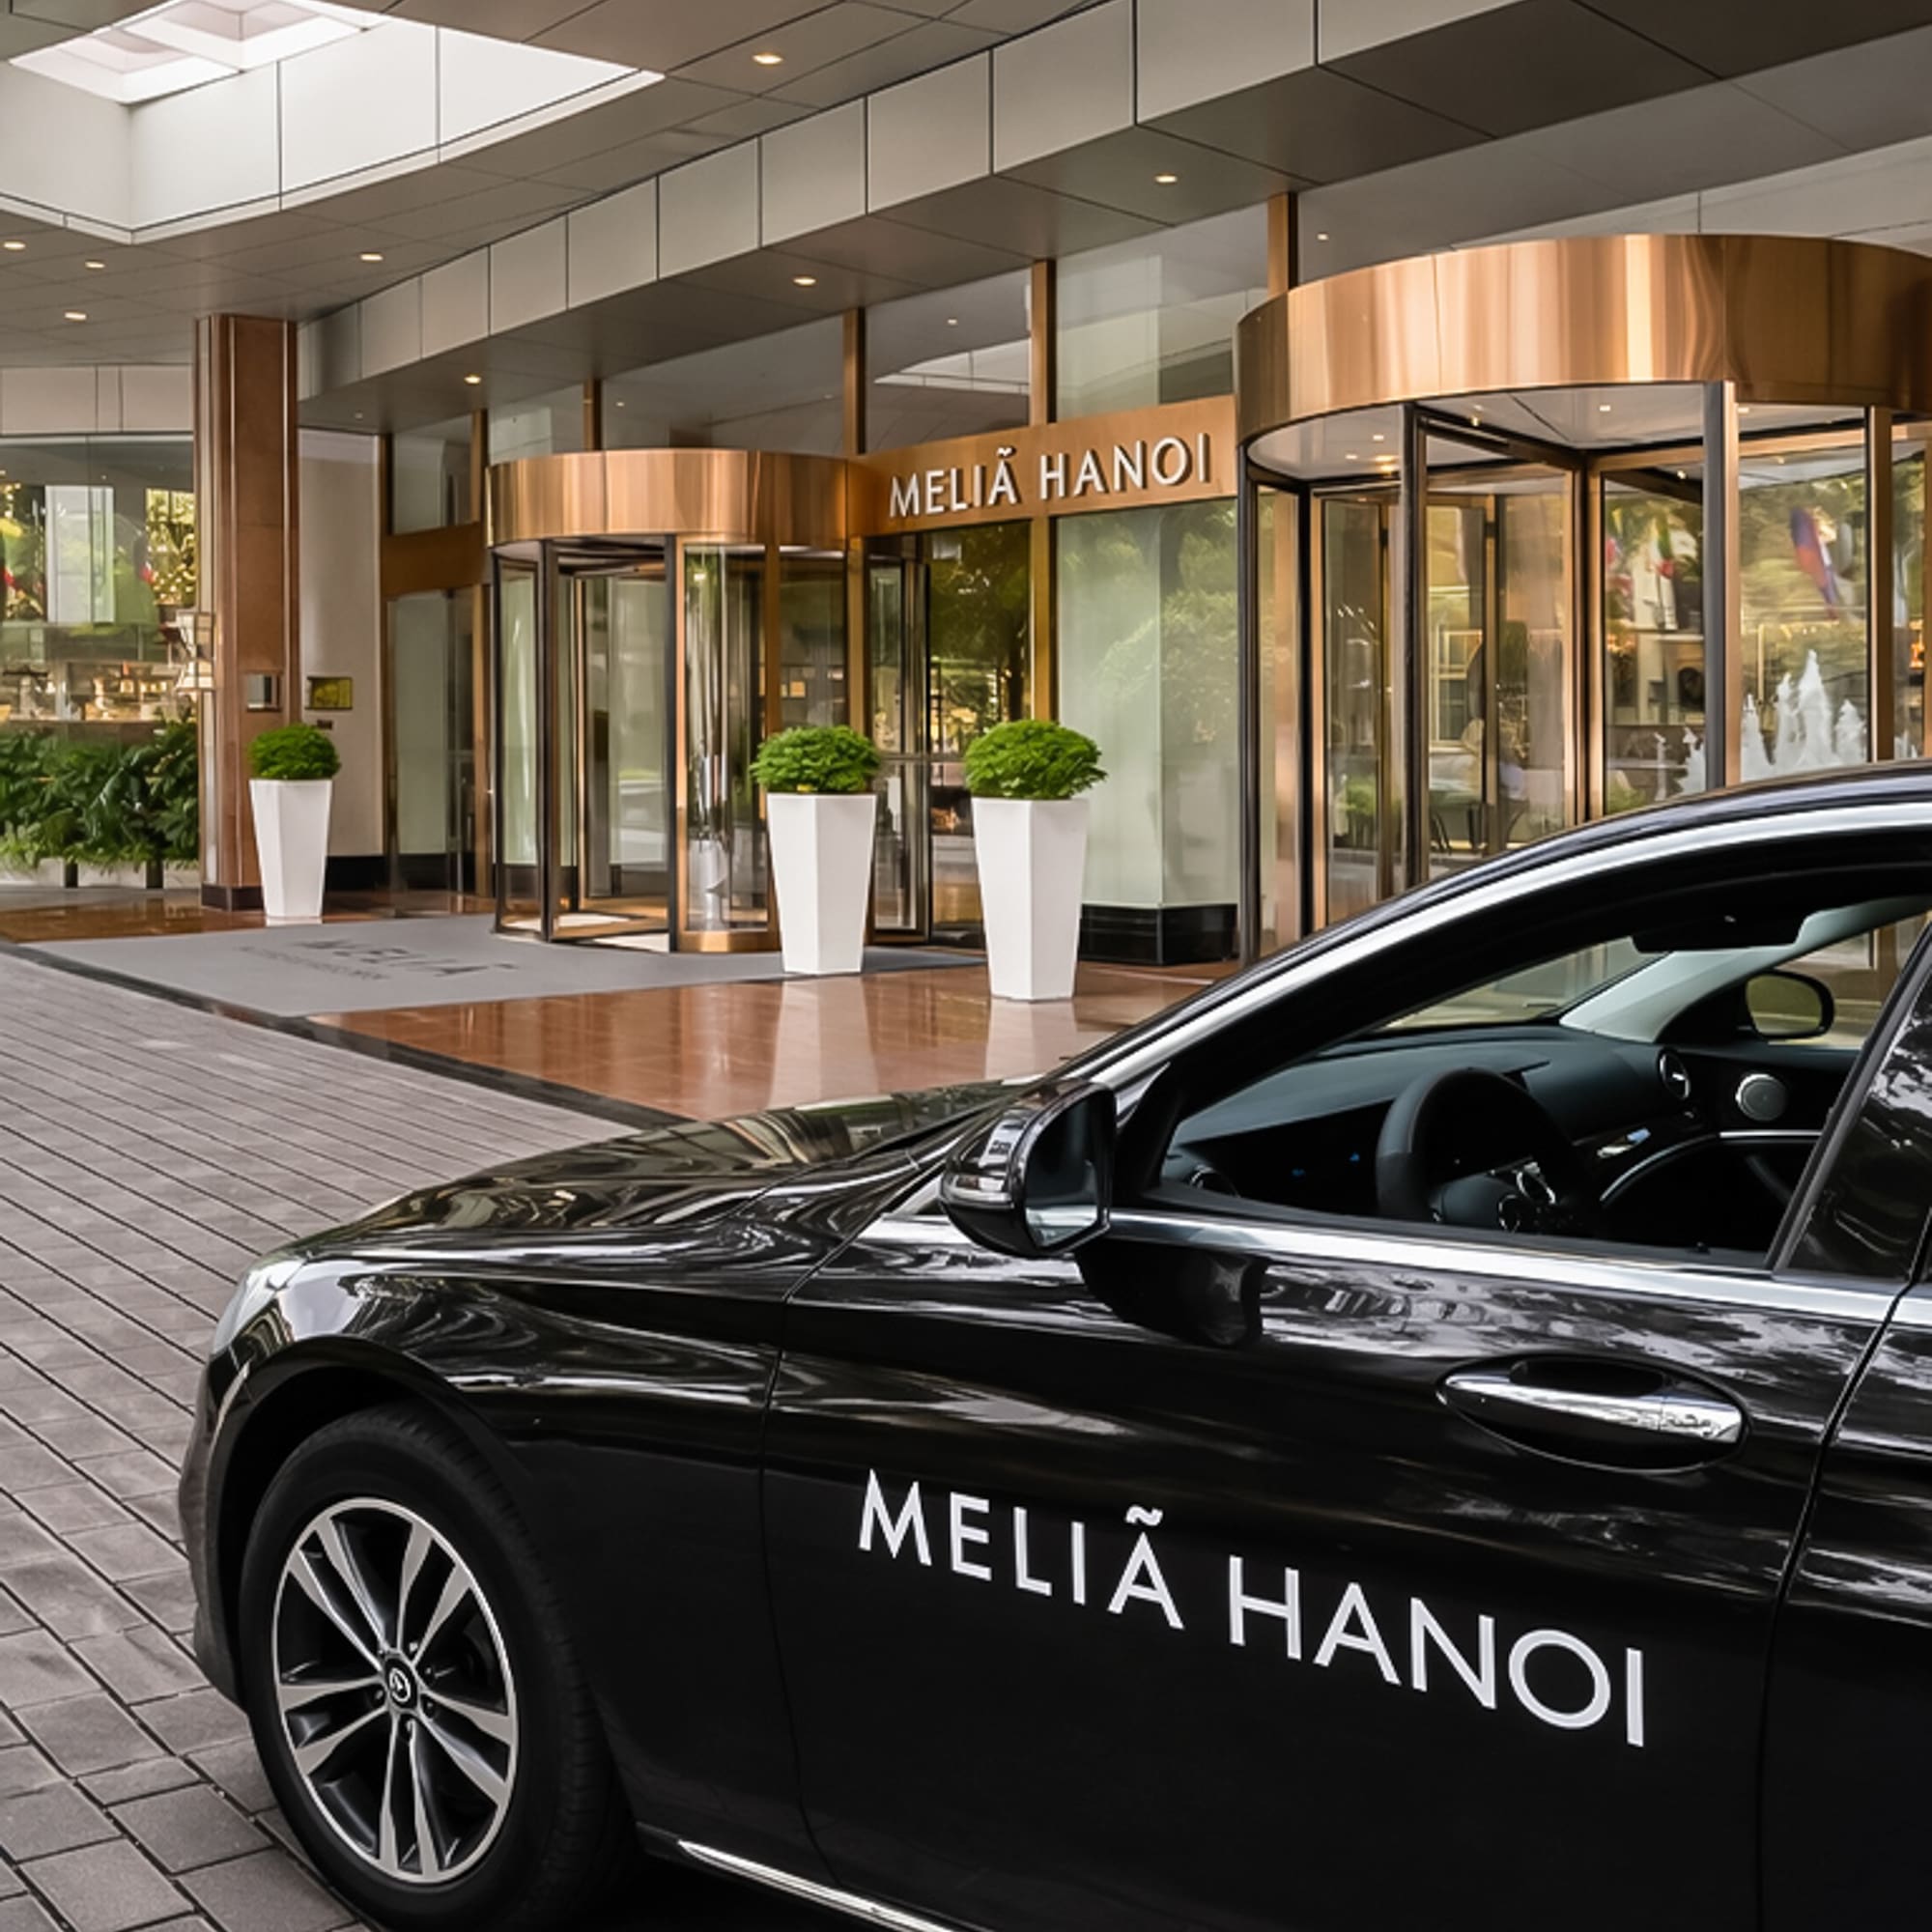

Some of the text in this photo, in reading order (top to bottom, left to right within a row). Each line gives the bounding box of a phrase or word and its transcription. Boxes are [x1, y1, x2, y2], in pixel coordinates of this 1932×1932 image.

[1039, 432, 1208, 500] HANOI
[859, 1468, 1644, 1747] MELIÃ HANOI
